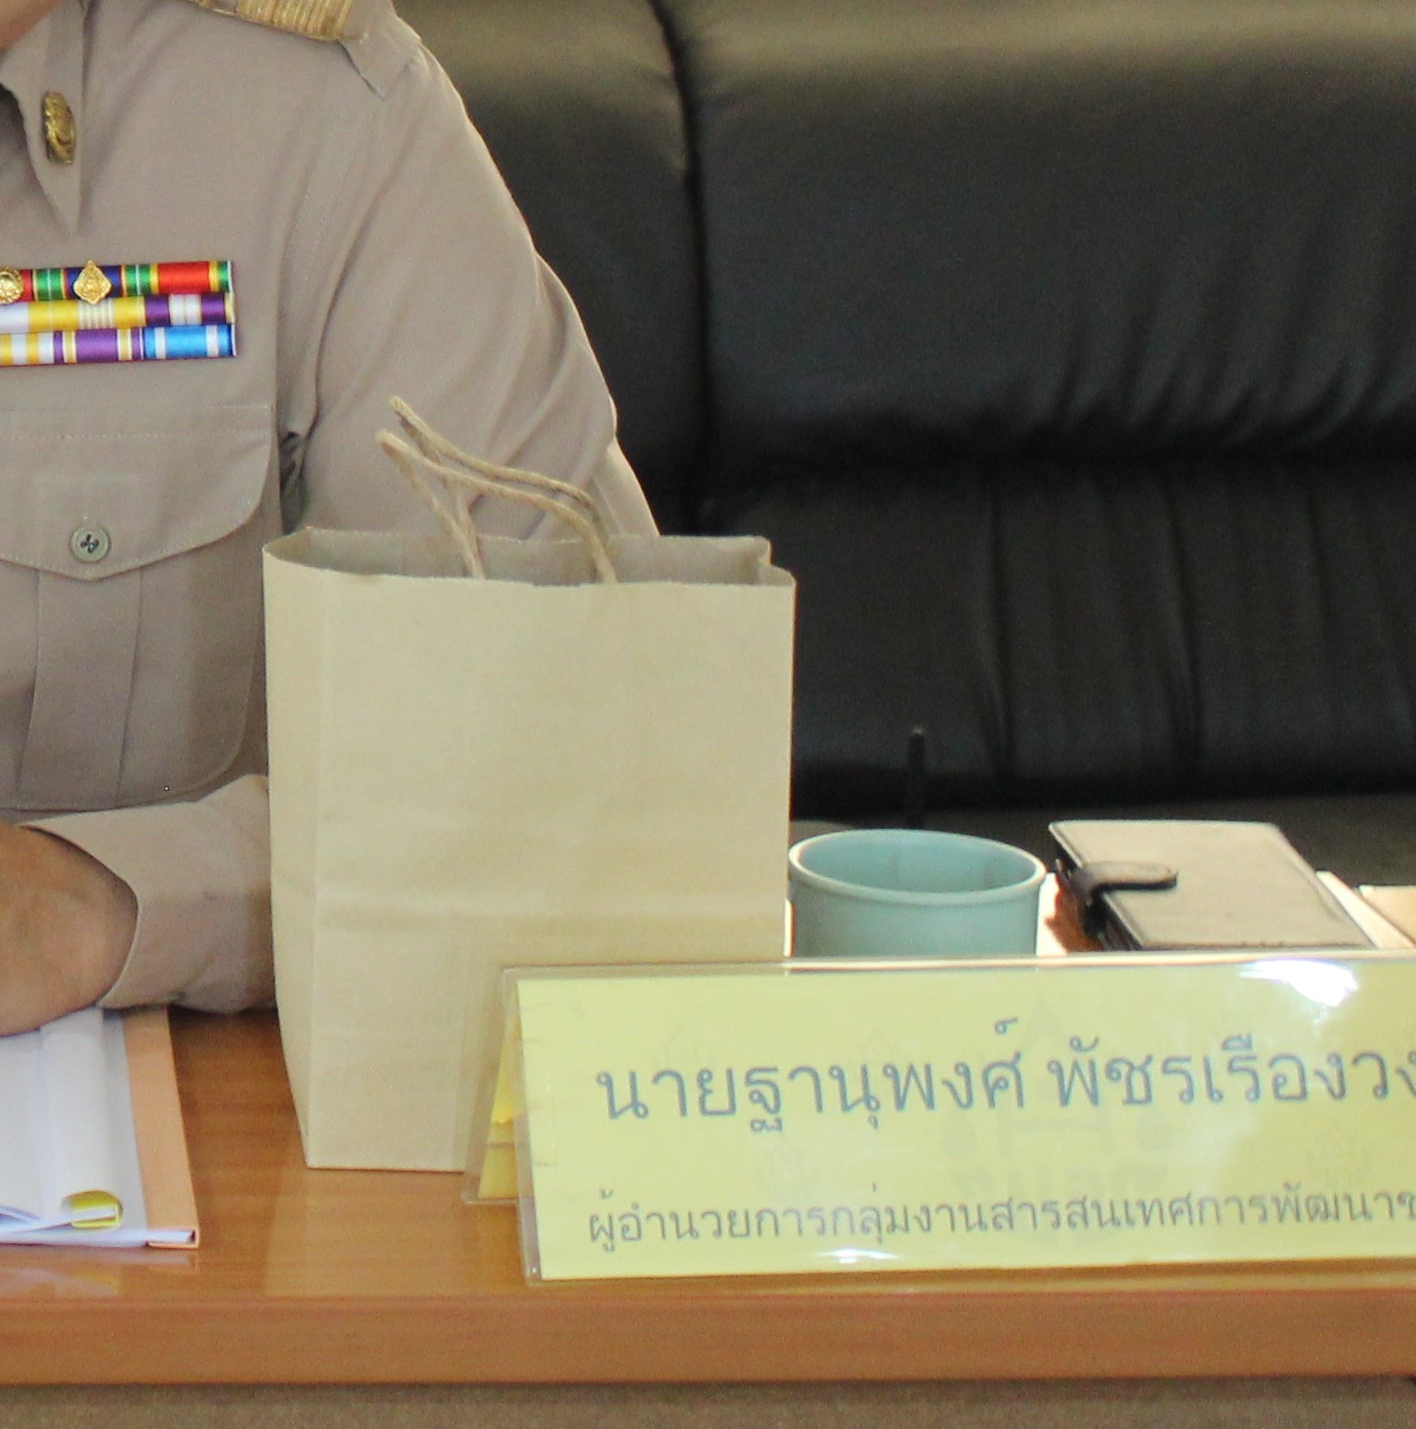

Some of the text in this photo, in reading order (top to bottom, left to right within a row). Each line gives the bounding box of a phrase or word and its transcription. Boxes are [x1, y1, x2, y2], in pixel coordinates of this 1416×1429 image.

[596, 1016, 1025, 1133] นายฐานุพงศ์
